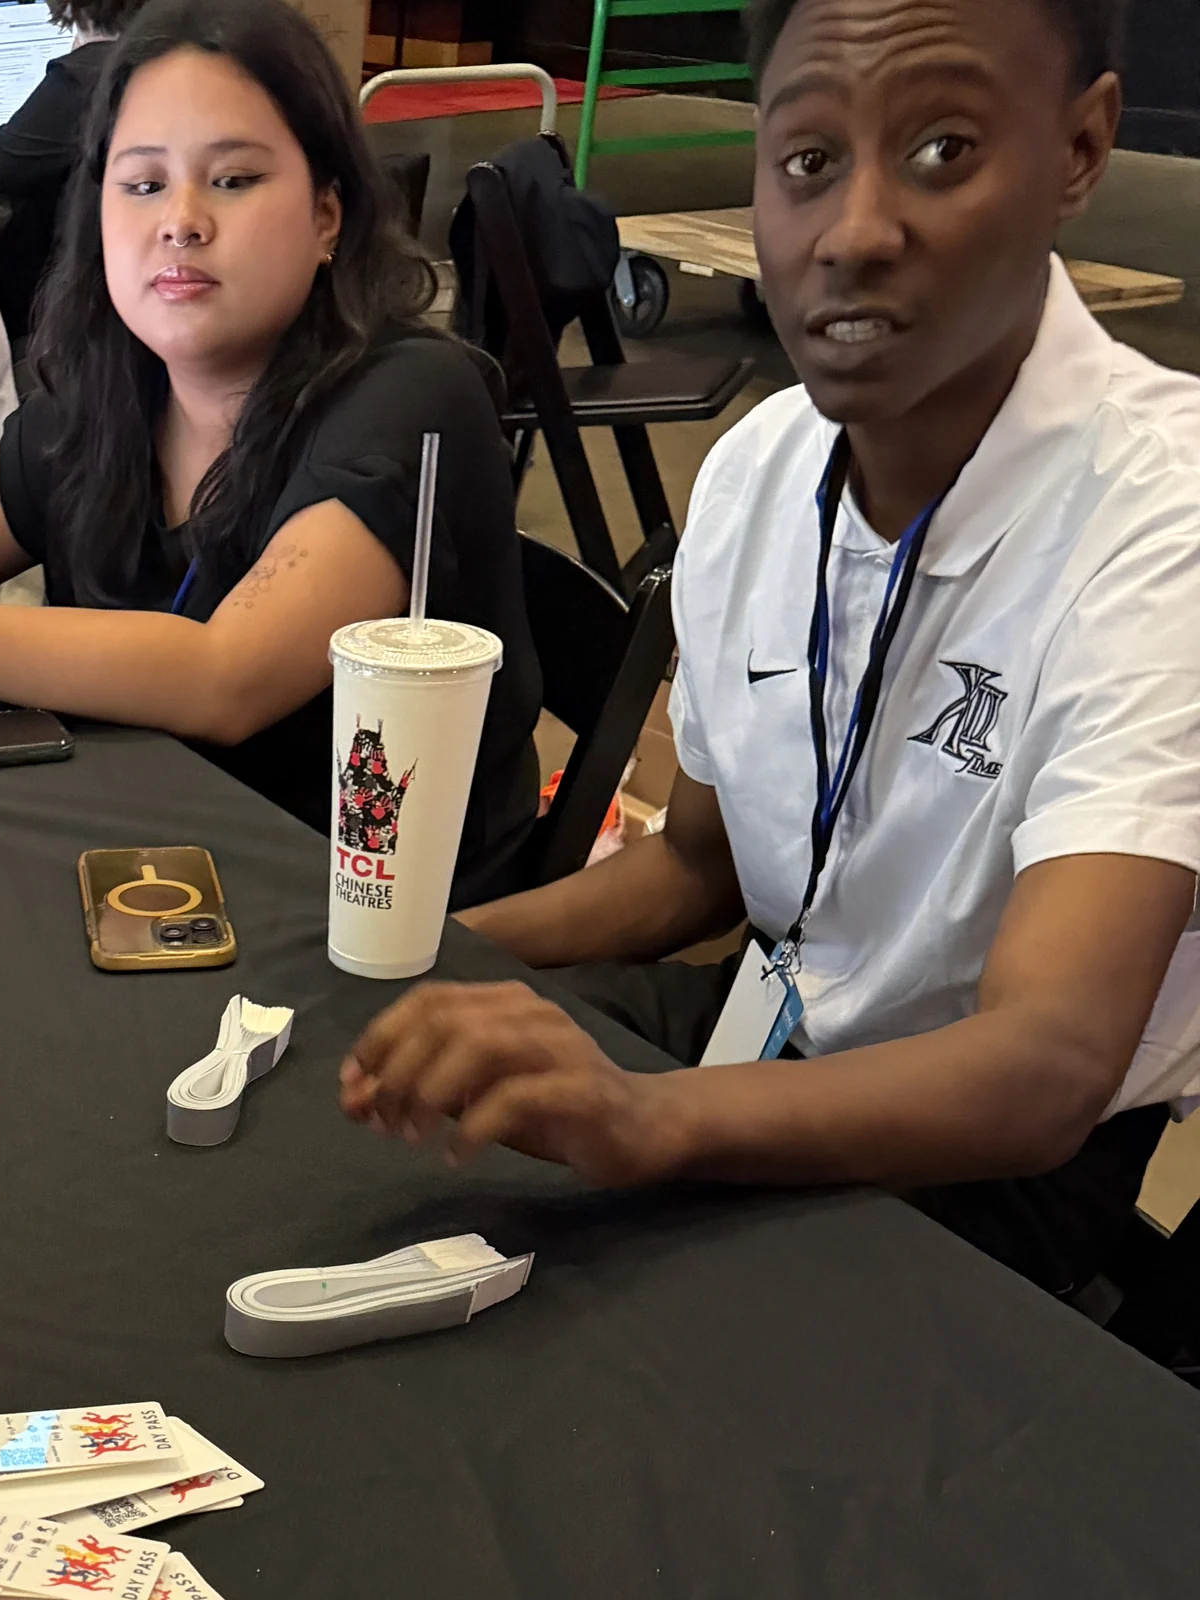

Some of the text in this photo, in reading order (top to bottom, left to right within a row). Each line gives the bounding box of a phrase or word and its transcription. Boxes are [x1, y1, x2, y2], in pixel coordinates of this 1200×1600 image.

[336, 846, 395, 880] TCL
[335, 872, 393, 898] CHINESE
[335, 884, 392, 910] THEATRES
[141, 1410, 172, 1450] DAY PASS
[218, 1466, 242, 1480] DA
[121, 1550, 158, 1600] DAY PASS
